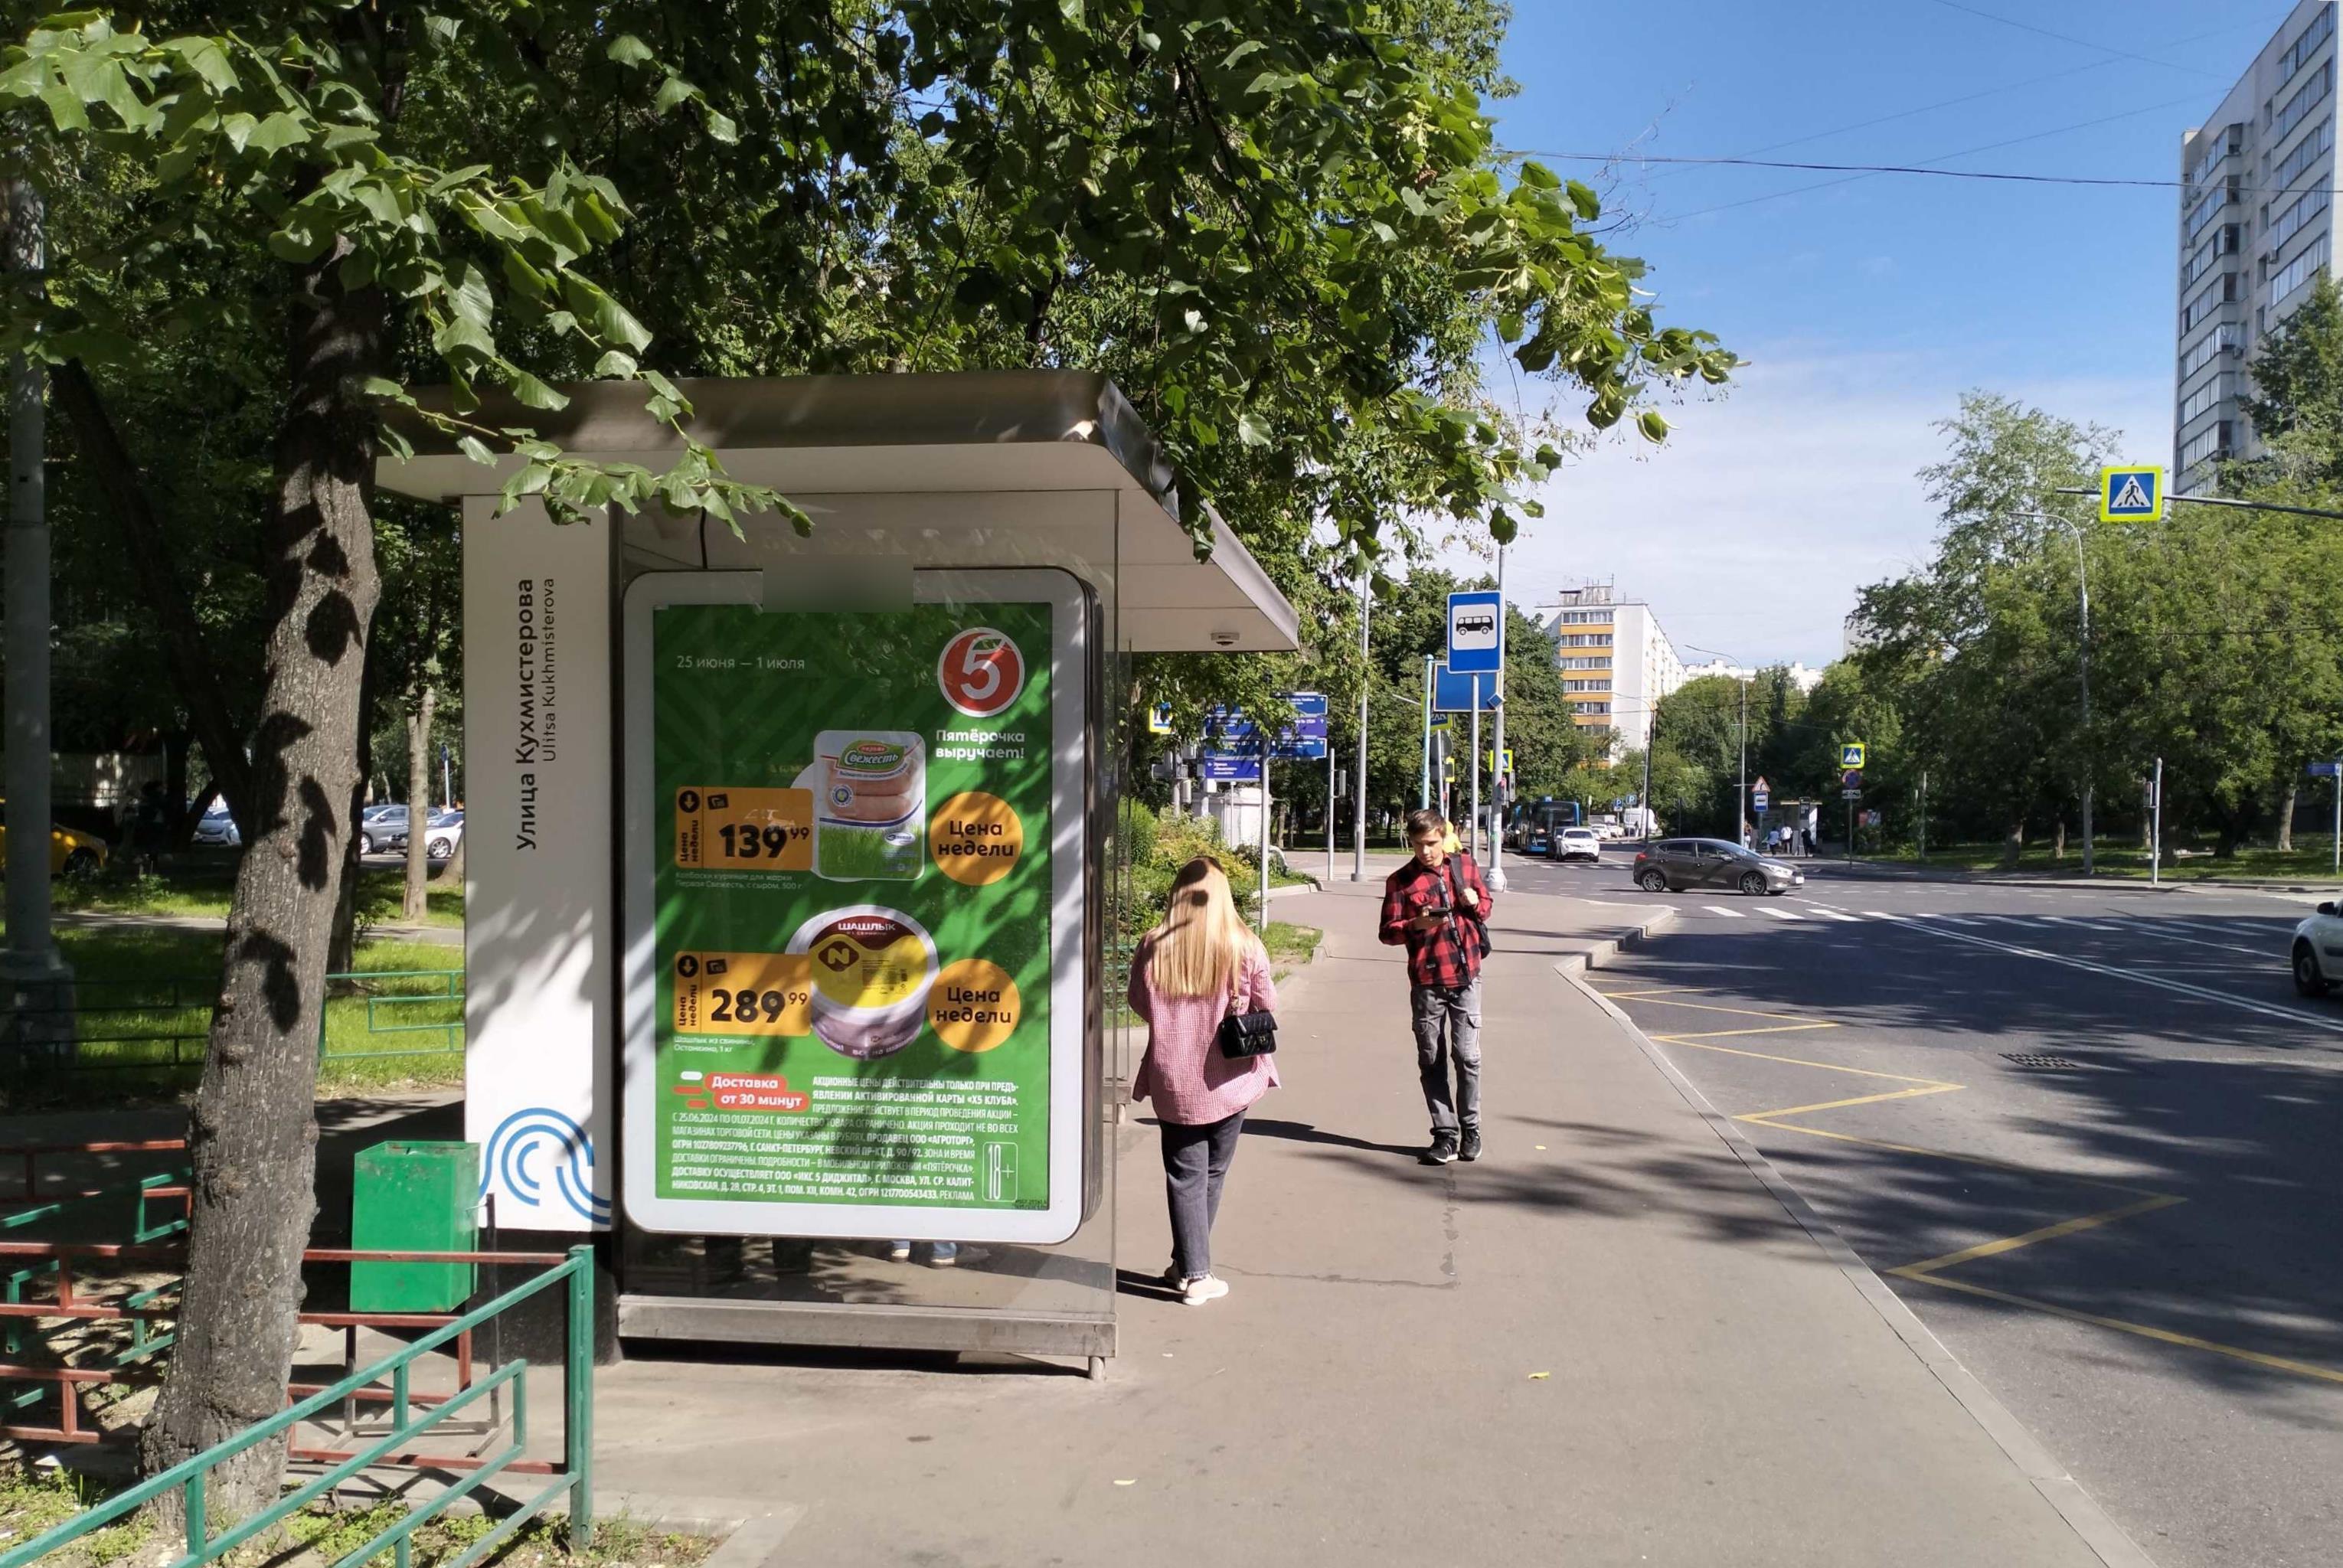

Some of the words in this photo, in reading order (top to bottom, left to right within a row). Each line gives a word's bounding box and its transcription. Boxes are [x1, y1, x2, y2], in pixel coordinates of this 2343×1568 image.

[542, 578, 556, 707] Kukhmisterova
[677, 655, 693, 668] 25
[697, 658, 736, 668] июня
[756, 656, 763, 668] 1
[766, 658, 806, 669] июля
[515, 579, 539, 764] Кухмистерова
[542, 713, 556, 762] Ulitsa
[936, 728, 1025, 744] Пятёрочка
[936, 748, 1024, 761] выручает!
[517, 773, 538, 851] Улица
[949, 821, 1002, 838] Цена
[681, 832, 689, 862] Цена
[690, 820, 698, 862] недели
[719, 824, 788, 858] 139
[938, 840, 1014, 857] недели
[838, 923, 896, 931] ШАШЛЫК
[947, 987, 1000, 1004] Цена
[678, 996, 687, 1026] Цена
[688, 985, 698, 1026] недели
[711, 988, 786, 1023] 289
[789, 992, 808, 1004] 99
[936, 1007, 1011, 1023] недели
[712, 1076, 779, 1089] Доставка
[946, 1080, 974, 1090] ТОЛЬКО
[975, 1081, 990, 1090] ПРИ
[721, 1095, 737, 1104] от
[740, 1094, 755, 1104] 30
[758, 1096, 802, 1109] минут
[812, 1091, 853, 1100] ЯВЛЕНИИ
[936, 1094, 965, 1103] КАРТЫ
[907, 1120, 933, 1132] АКЦИЯ
[935, 1121, 974, 1133] ПРОХОДИТ
[975, 1122, 985, 1132] НЕ
[988, 1122, 998, 1132] ВО
[999, 1123, 1018, 1133] ВСЕХ
[910, 1135, 926, 1144] ООО
[775, 1171, 791, 1180] ООО
[988, 1144, 1015, 1200] 18+
[858, 1187, 879, 1197] ОГРН
[939, 1190, 974, 1200] РЕКЛАМА
